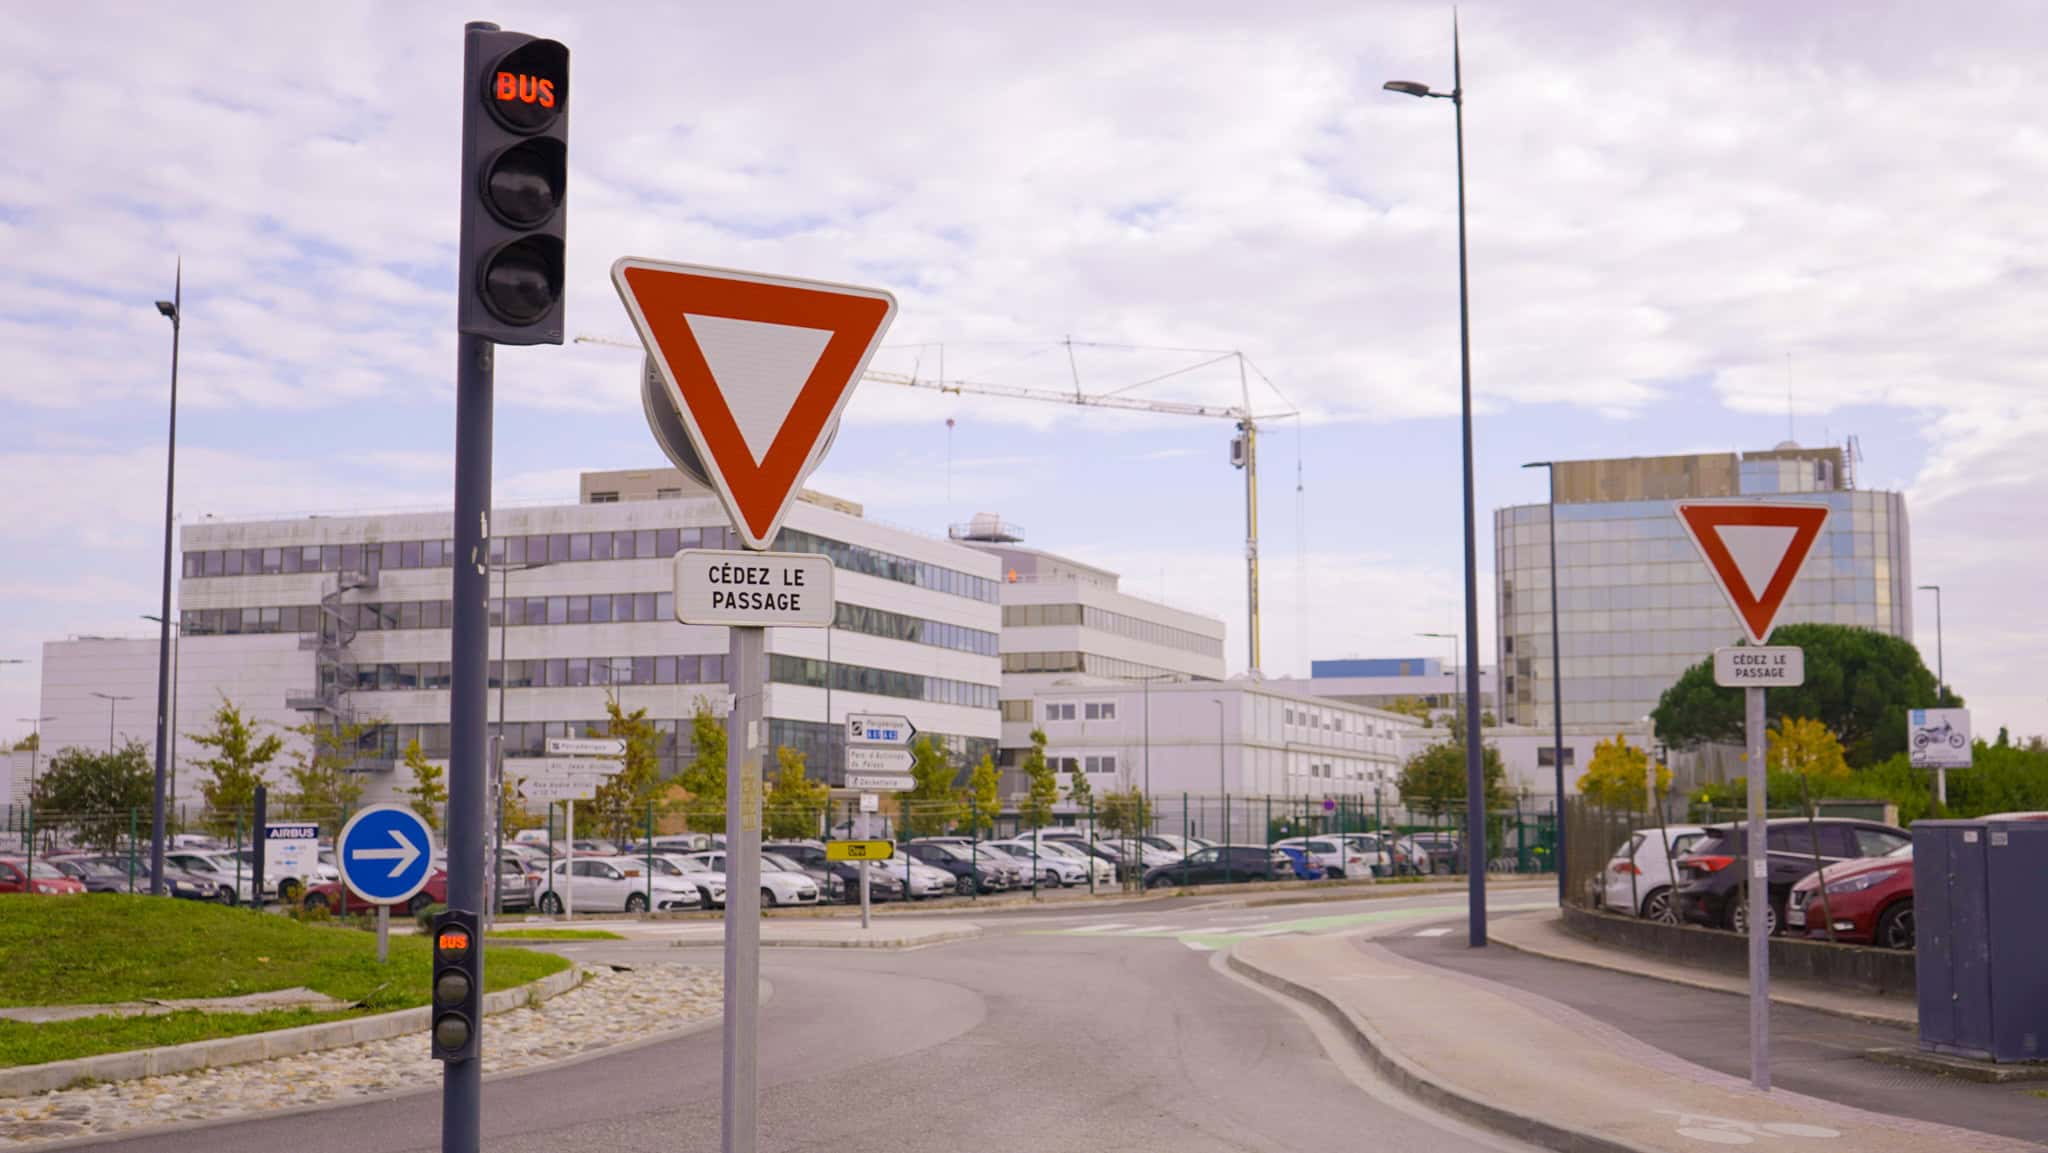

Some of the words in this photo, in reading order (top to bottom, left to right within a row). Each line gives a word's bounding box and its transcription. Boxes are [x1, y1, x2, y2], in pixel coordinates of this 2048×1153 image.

[496, 71, 555, 108] BUS
[708, 562, 770, 585] CÉDEZ
[784, 568, 805, 586] LE
[712, 591, 801, 611] PASSAGE
[1733, 653, 1767, 665] CÉDEZ
[1774, 655, 1786, 665] LE
[1735, 667, 1785, 678] PASSAGE
[270, 828, 315, 838] AIRBUS
[439, 935, 466, 949] BUS
